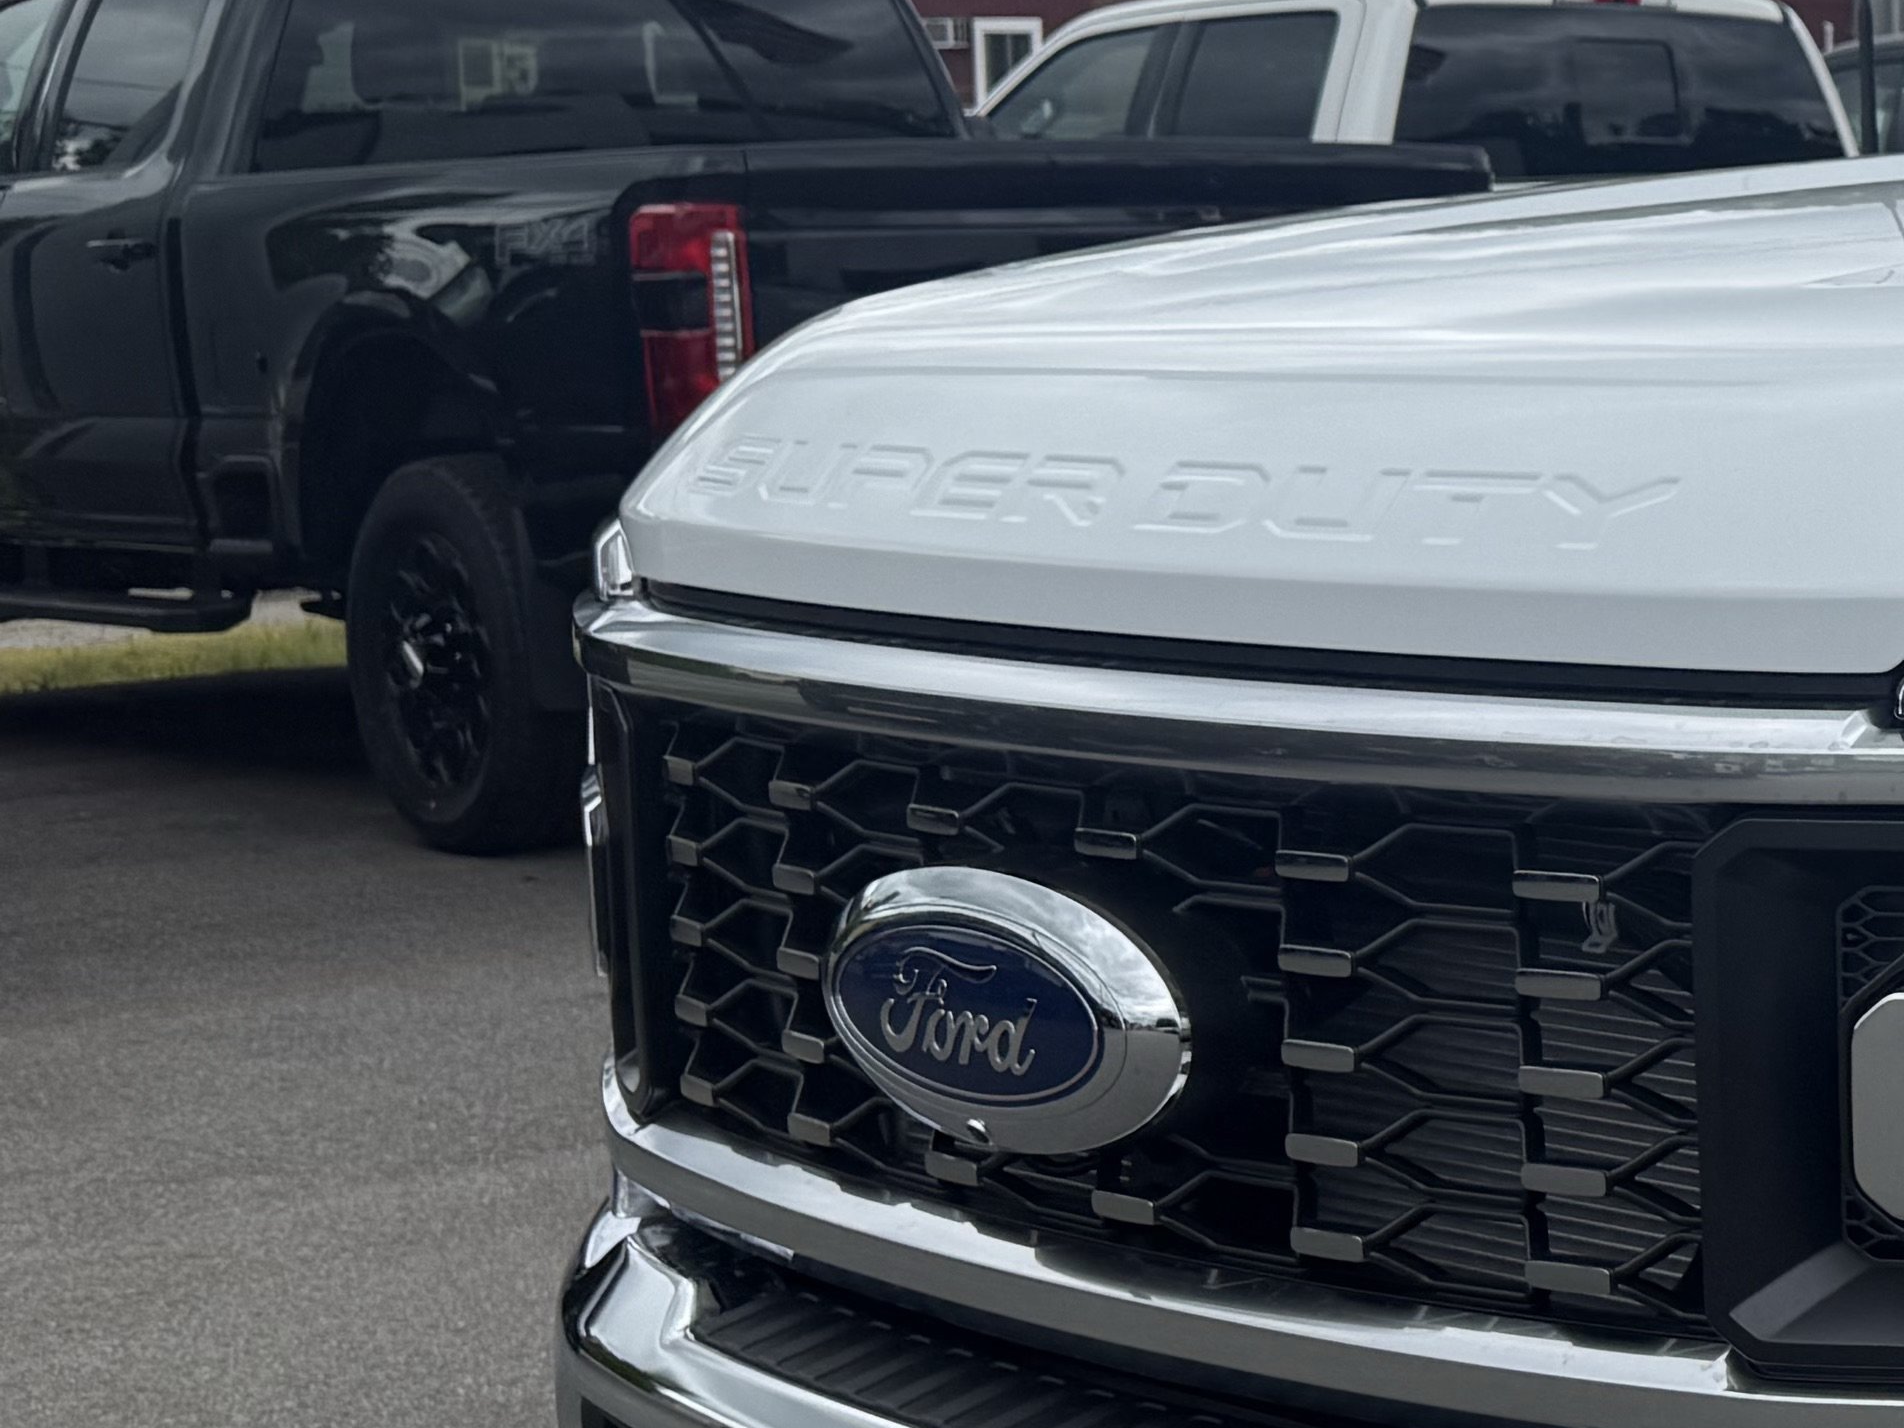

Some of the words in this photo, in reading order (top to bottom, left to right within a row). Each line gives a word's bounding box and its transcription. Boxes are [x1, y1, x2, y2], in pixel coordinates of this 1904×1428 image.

[697, 434, 1130, 528] SUPER
[1132, 461, 1684, 551] DUTY
[879, 945, 1039, 1077] Ford
